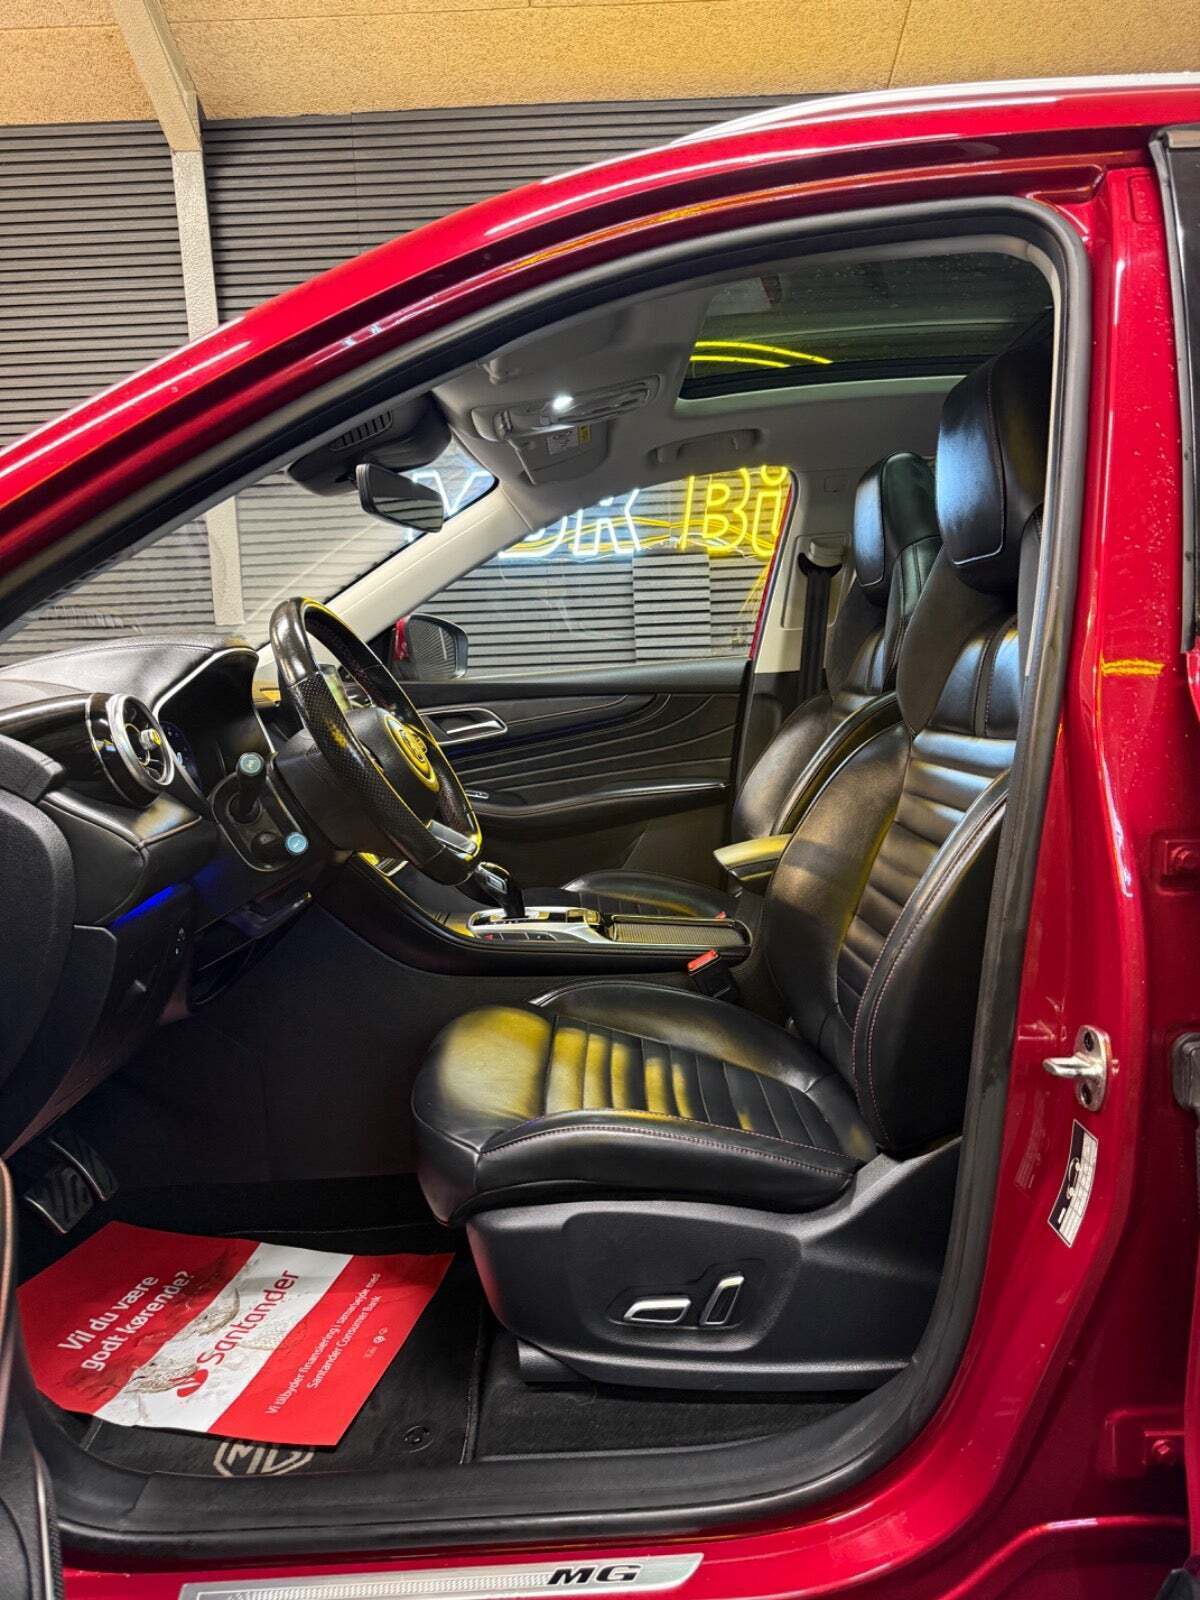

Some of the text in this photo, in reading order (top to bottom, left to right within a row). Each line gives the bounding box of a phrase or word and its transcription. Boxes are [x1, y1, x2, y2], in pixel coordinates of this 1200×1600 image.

[57, 1276, 159, 1350] Vil du være
[81, 1270, 195, 1371] godt kørende?
[197, 1270, 299, 1365] Santander
[306, 1348, 343, 1388] Santander
[335, 1311, 369, 1348] Consumer
[361, 1295, 382, 1312] Bank
[547, 1564, 642, 1585] MG
